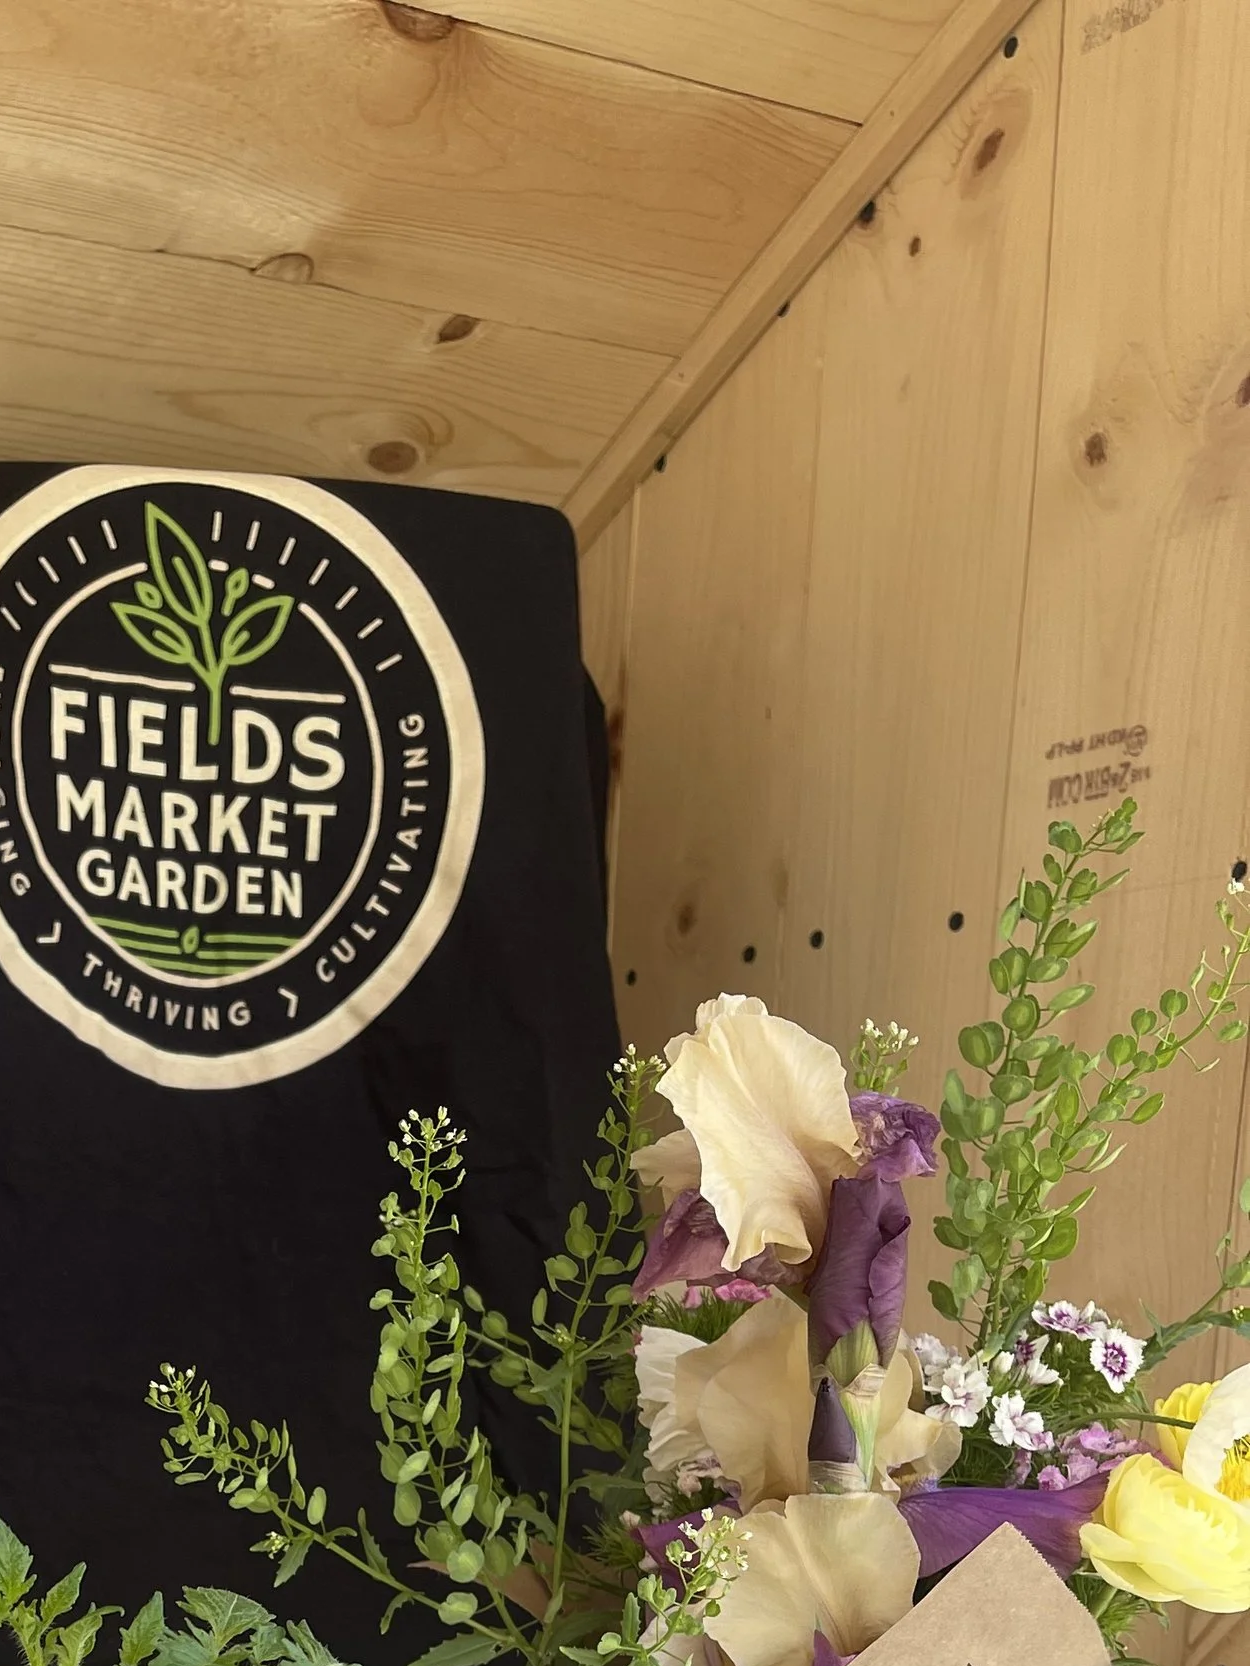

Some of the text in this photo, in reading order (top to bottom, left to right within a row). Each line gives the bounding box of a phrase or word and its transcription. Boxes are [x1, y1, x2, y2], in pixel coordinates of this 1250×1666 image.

[50, 686, 346, 791] FIELDS
[56, 774, 338, 862] MARKET
[315, 712, 430, 984] CULTIVATING
[77, 849, 304, 918] GARDEN
[82, 952, 252, 1031] THRIVING
